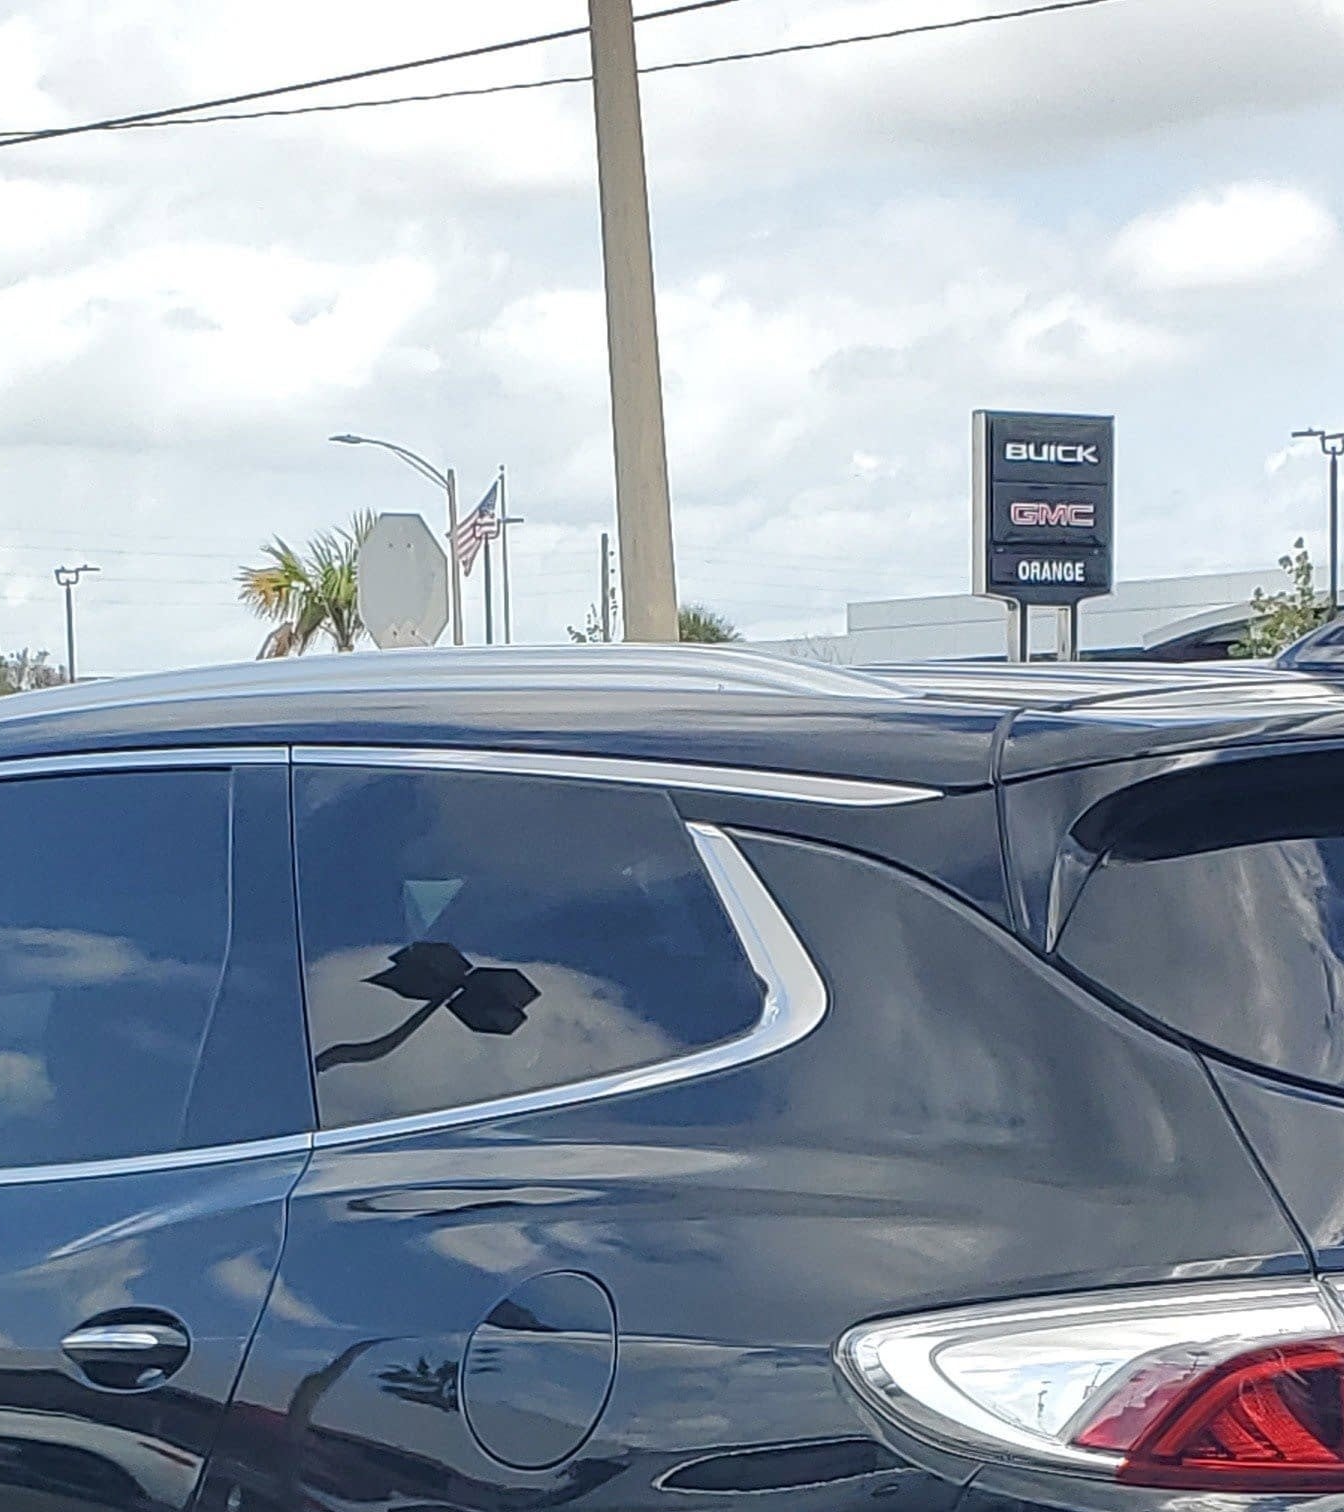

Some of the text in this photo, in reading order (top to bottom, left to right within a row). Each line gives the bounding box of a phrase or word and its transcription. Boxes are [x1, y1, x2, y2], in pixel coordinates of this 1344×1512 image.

[1005, 442, 1099, 464] BUICK
[1010, 501, 1095, 527] GMC
[1017, 560, 1086, 582] ORANGE
